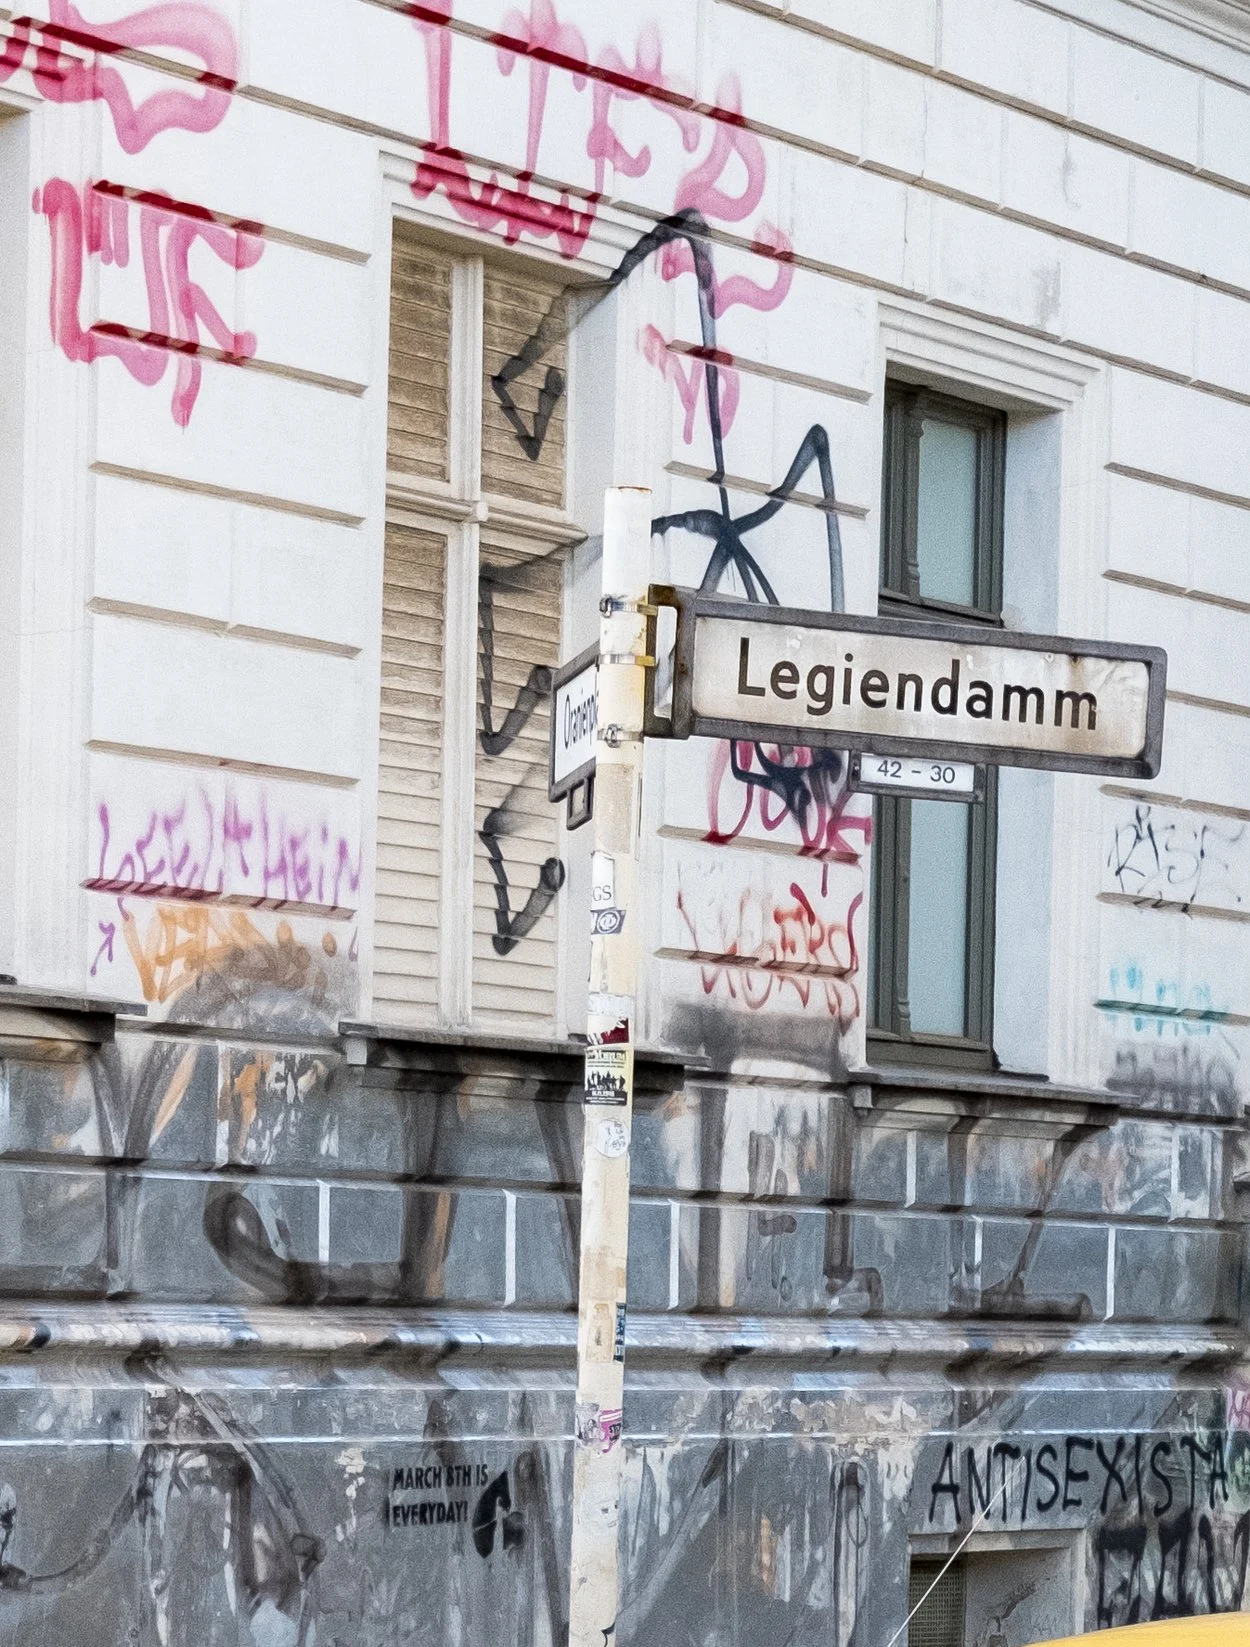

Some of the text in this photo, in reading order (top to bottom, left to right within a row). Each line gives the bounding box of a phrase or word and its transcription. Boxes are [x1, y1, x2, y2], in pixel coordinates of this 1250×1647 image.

[738, 637, 1097, 731] Legiendamm
[564, 693, 598, 750] Oranienp
[877, 760, 902, 778] 42
[930, 765, 956, 784] 30
[393, 1464, 488, 1490] MARCH 8TH IS
[392, 1501, 468, 1526] EVERYDAY!
